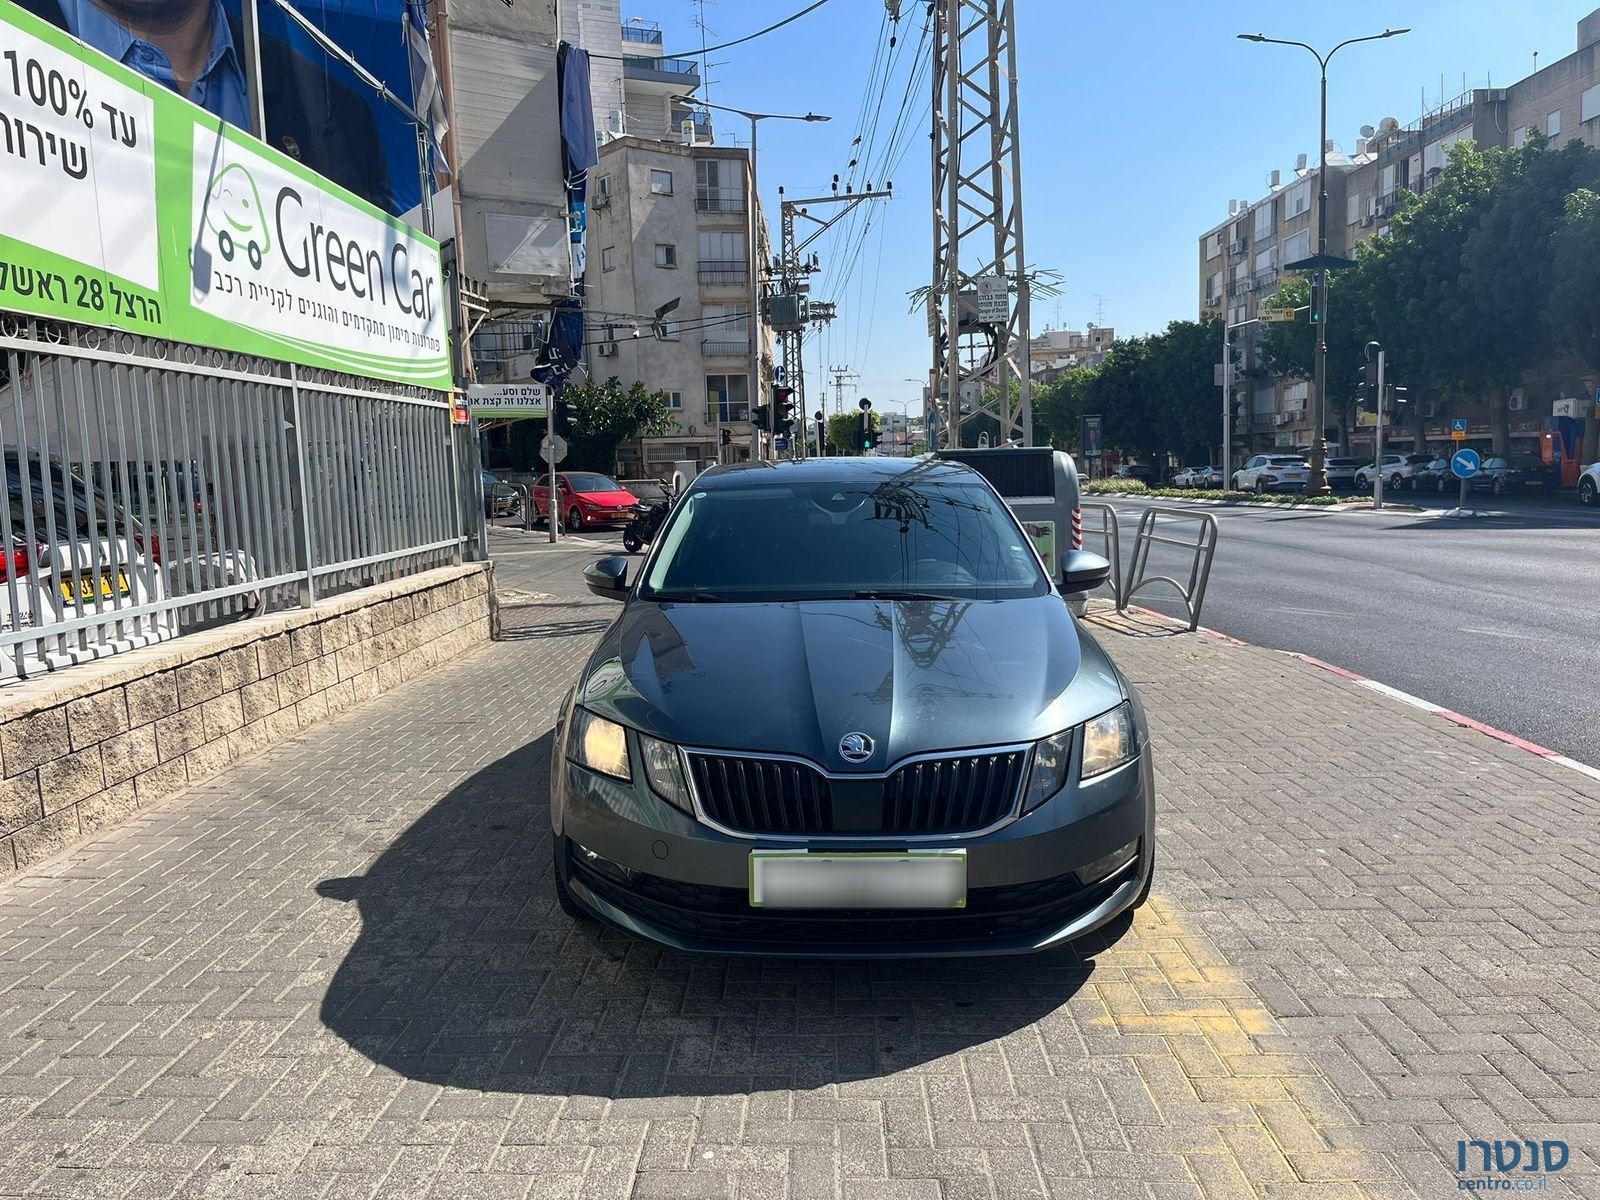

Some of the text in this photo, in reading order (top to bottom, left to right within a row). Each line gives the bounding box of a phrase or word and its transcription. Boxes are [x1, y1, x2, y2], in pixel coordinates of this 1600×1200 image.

[4, 50, 137, 148] עד 100%
[275, 186, 434, 321] Green Car
[74, 275, 104, 311] 28
[214, 270, 242, 297] רכב
[109, 281, 161, 324] הרצל
[248, 281, 293, 314] לקניית
[298, 297, 338, 323] והוגנים
[342, 311, 385, 338] מתקדמים
[388, 324, 410, 343] מימון
[482, 397, 502, 407] קצת
[494, 387, 541, 396] שלם וסע...
[504, 397, 515, 405] זה
[517, 396, 542, 406] אצלנו
